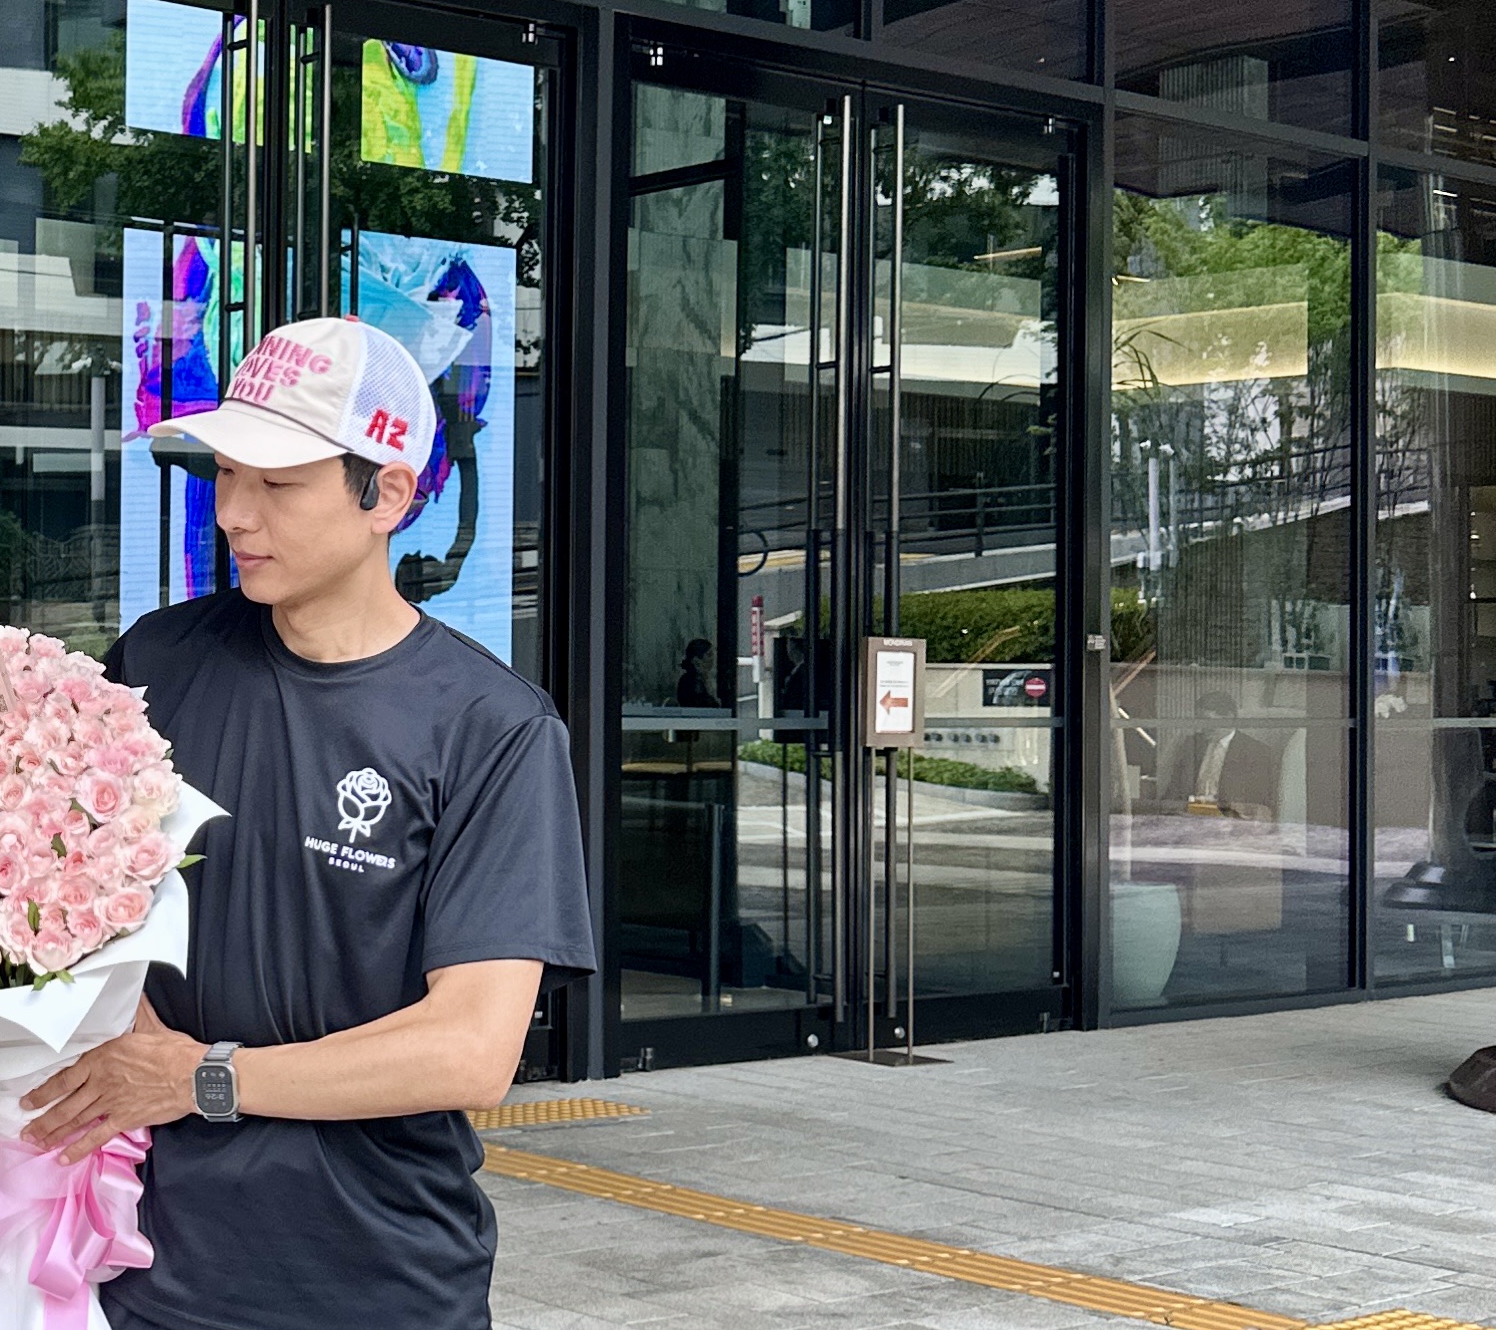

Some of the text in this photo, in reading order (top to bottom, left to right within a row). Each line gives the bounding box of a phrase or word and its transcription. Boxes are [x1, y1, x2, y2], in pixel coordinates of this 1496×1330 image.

[304, 836, 396, 869] HUGE FLOWERS
[328, 856, 364, 873] SEOUL
